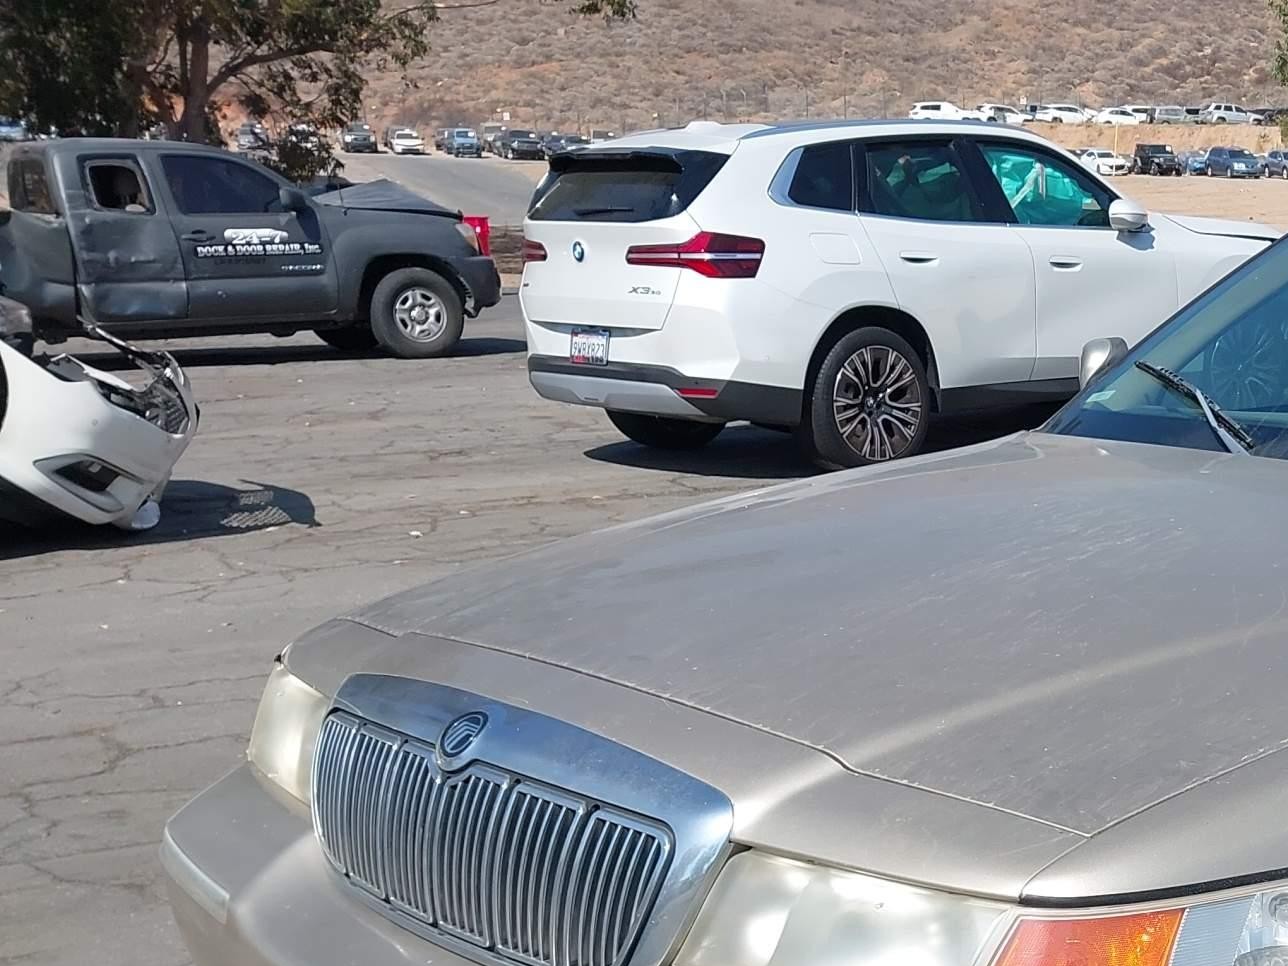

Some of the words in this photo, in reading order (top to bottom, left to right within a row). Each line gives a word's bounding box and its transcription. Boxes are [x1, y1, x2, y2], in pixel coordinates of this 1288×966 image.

[231, 231, 281, 244] 24-7
[196, 245, 226, 257] DOCK
[227, 244, 236, 256] &
[236, 244, 265, 256] DOOR
